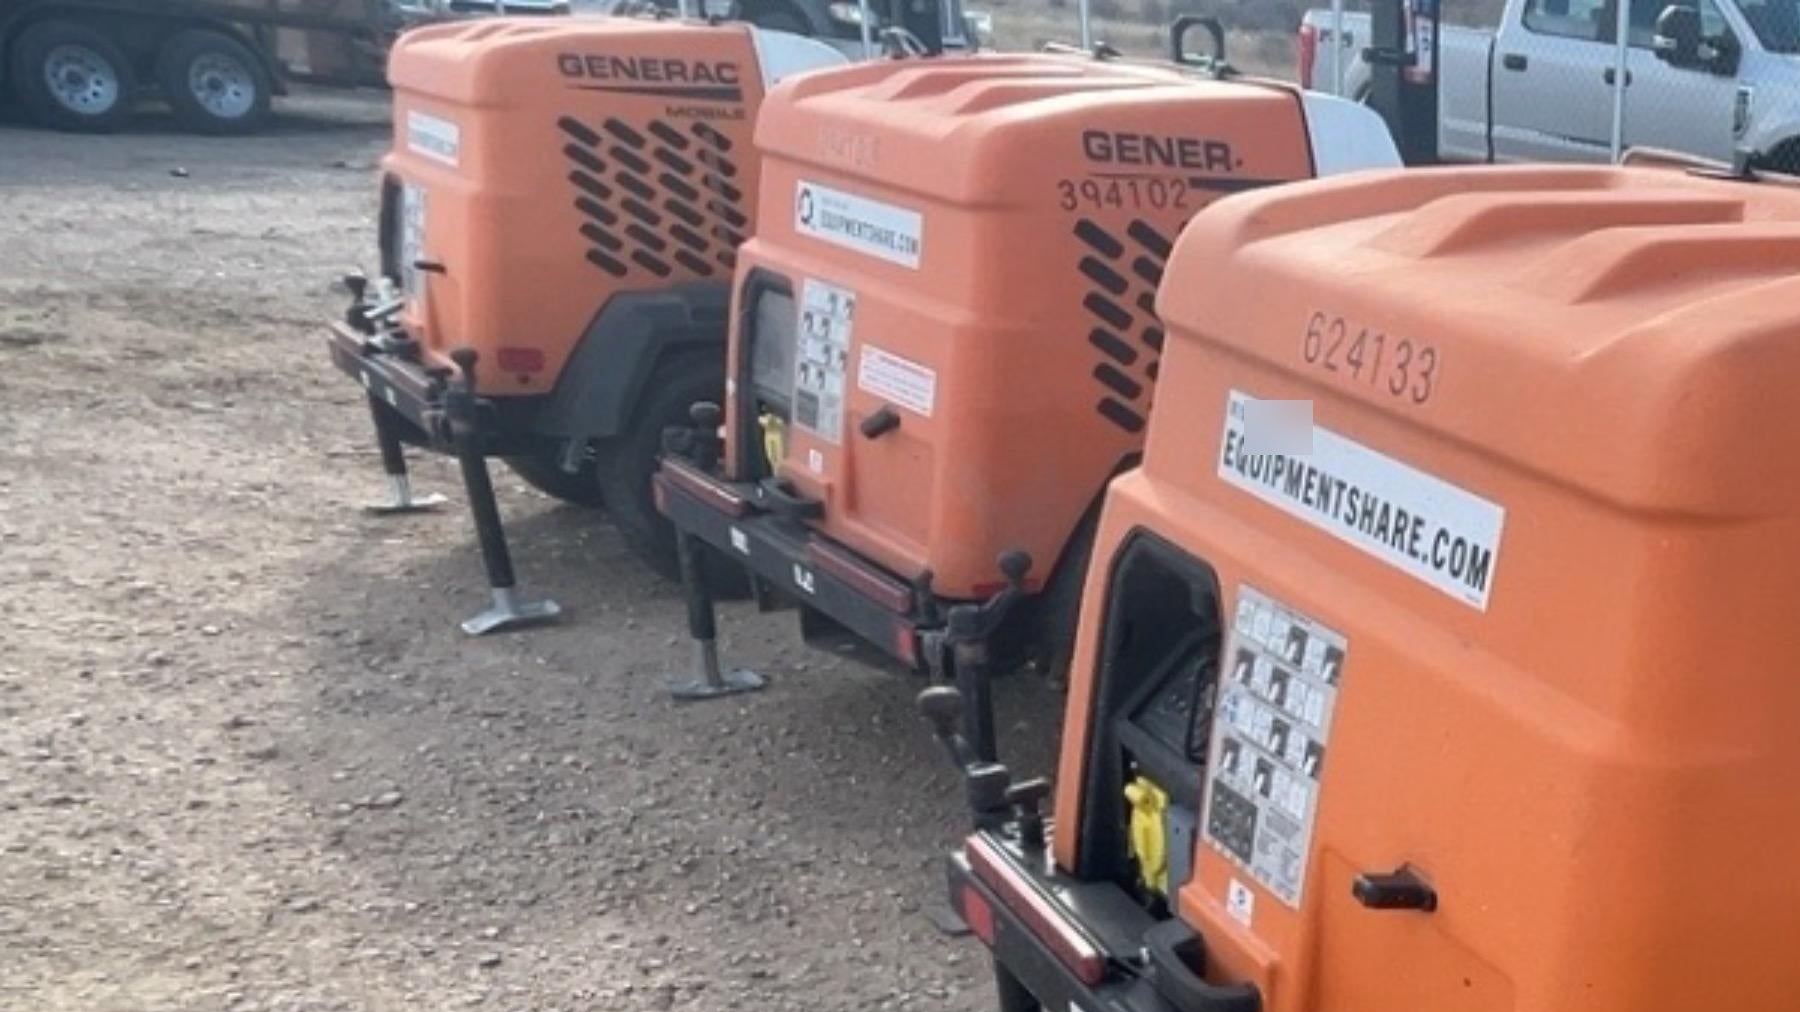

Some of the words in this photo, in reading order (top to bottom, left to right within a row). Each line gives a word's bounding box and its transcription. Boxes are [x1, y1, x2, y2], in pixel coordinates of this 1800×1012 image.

[557, 53, 740, 84] GENERAC
[665, 106, 746, 120] MOBILE
[1083, 130, 1243, 172] GENER
[1058, 178, 1188, 211] 394102
[1304, 311, 1436, 404] 624133
